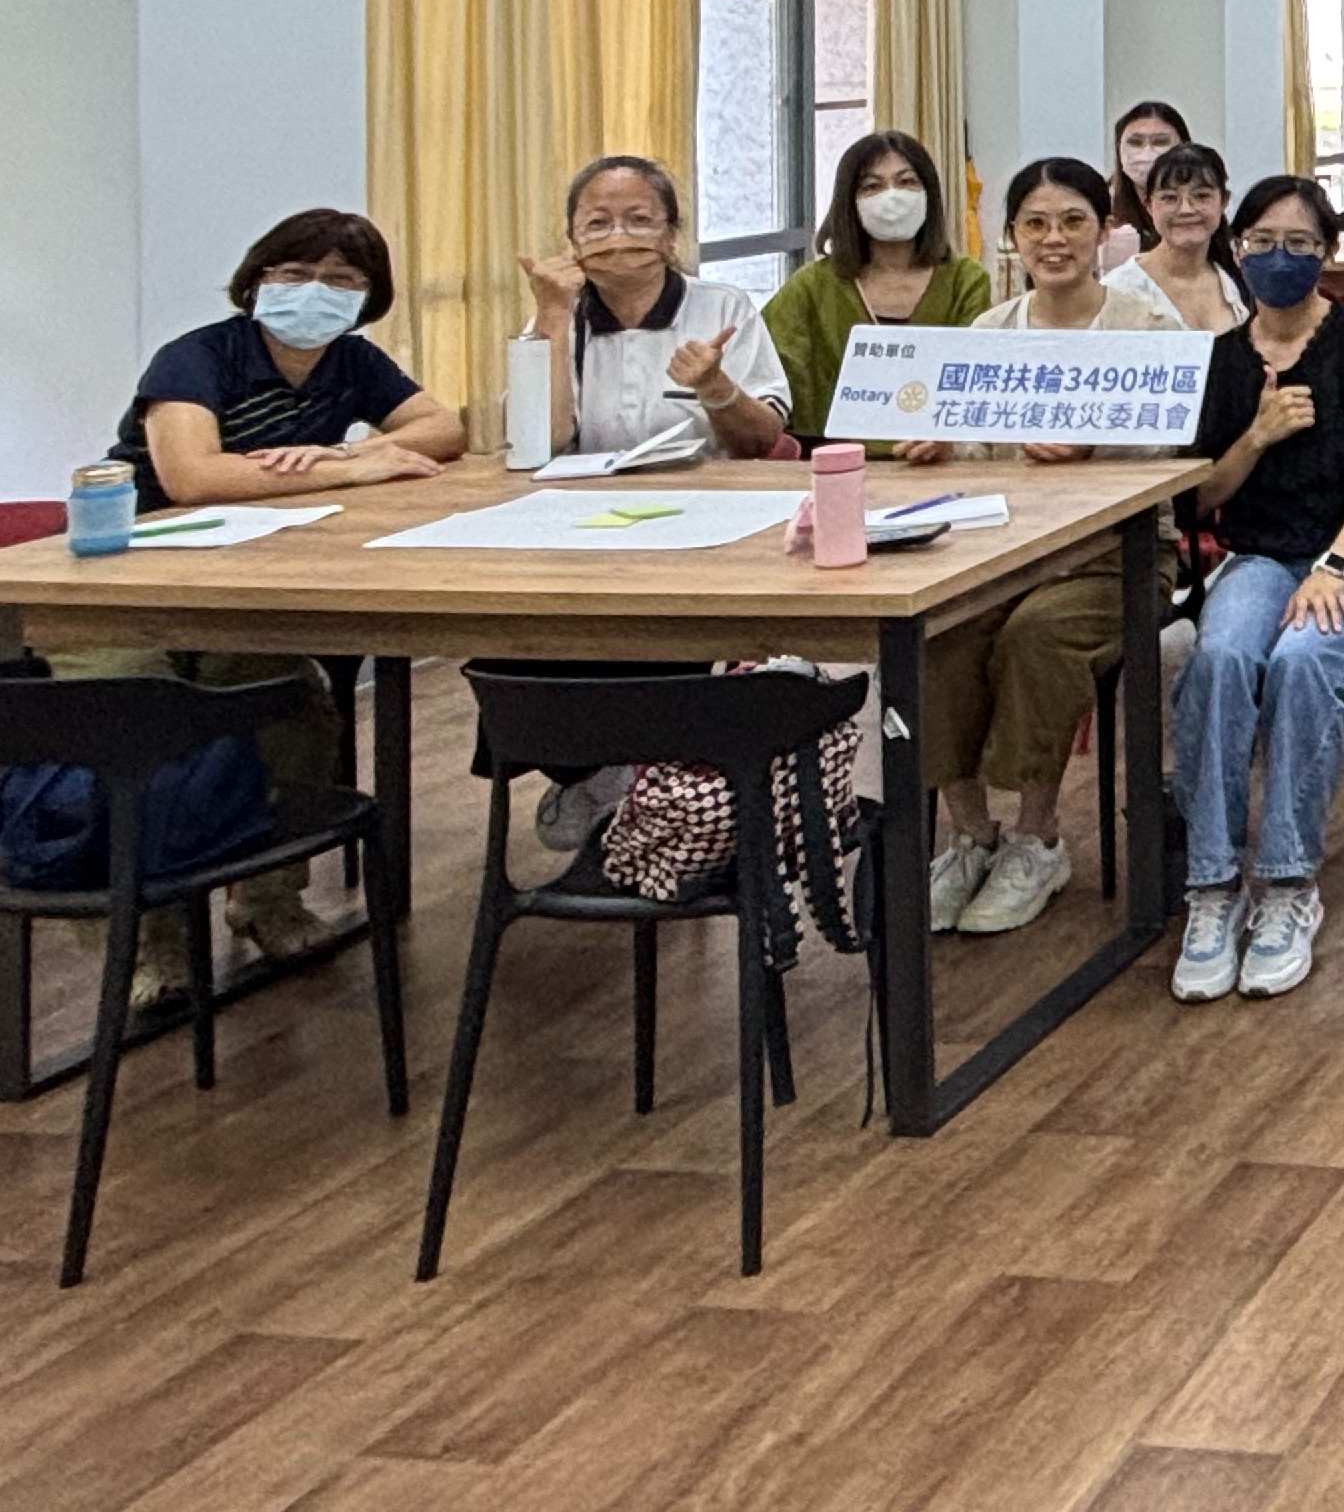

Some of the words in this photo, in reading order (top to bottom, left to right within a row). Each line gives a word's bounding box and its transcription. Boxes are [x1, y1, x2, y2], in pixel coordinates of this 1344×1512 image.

[936, 362, 1202, 395] 國際扶輪3490地區
[840, 386, 894, 405] Rotary
[932, 400, 1192, 431] 花蓮光復救災委員會
